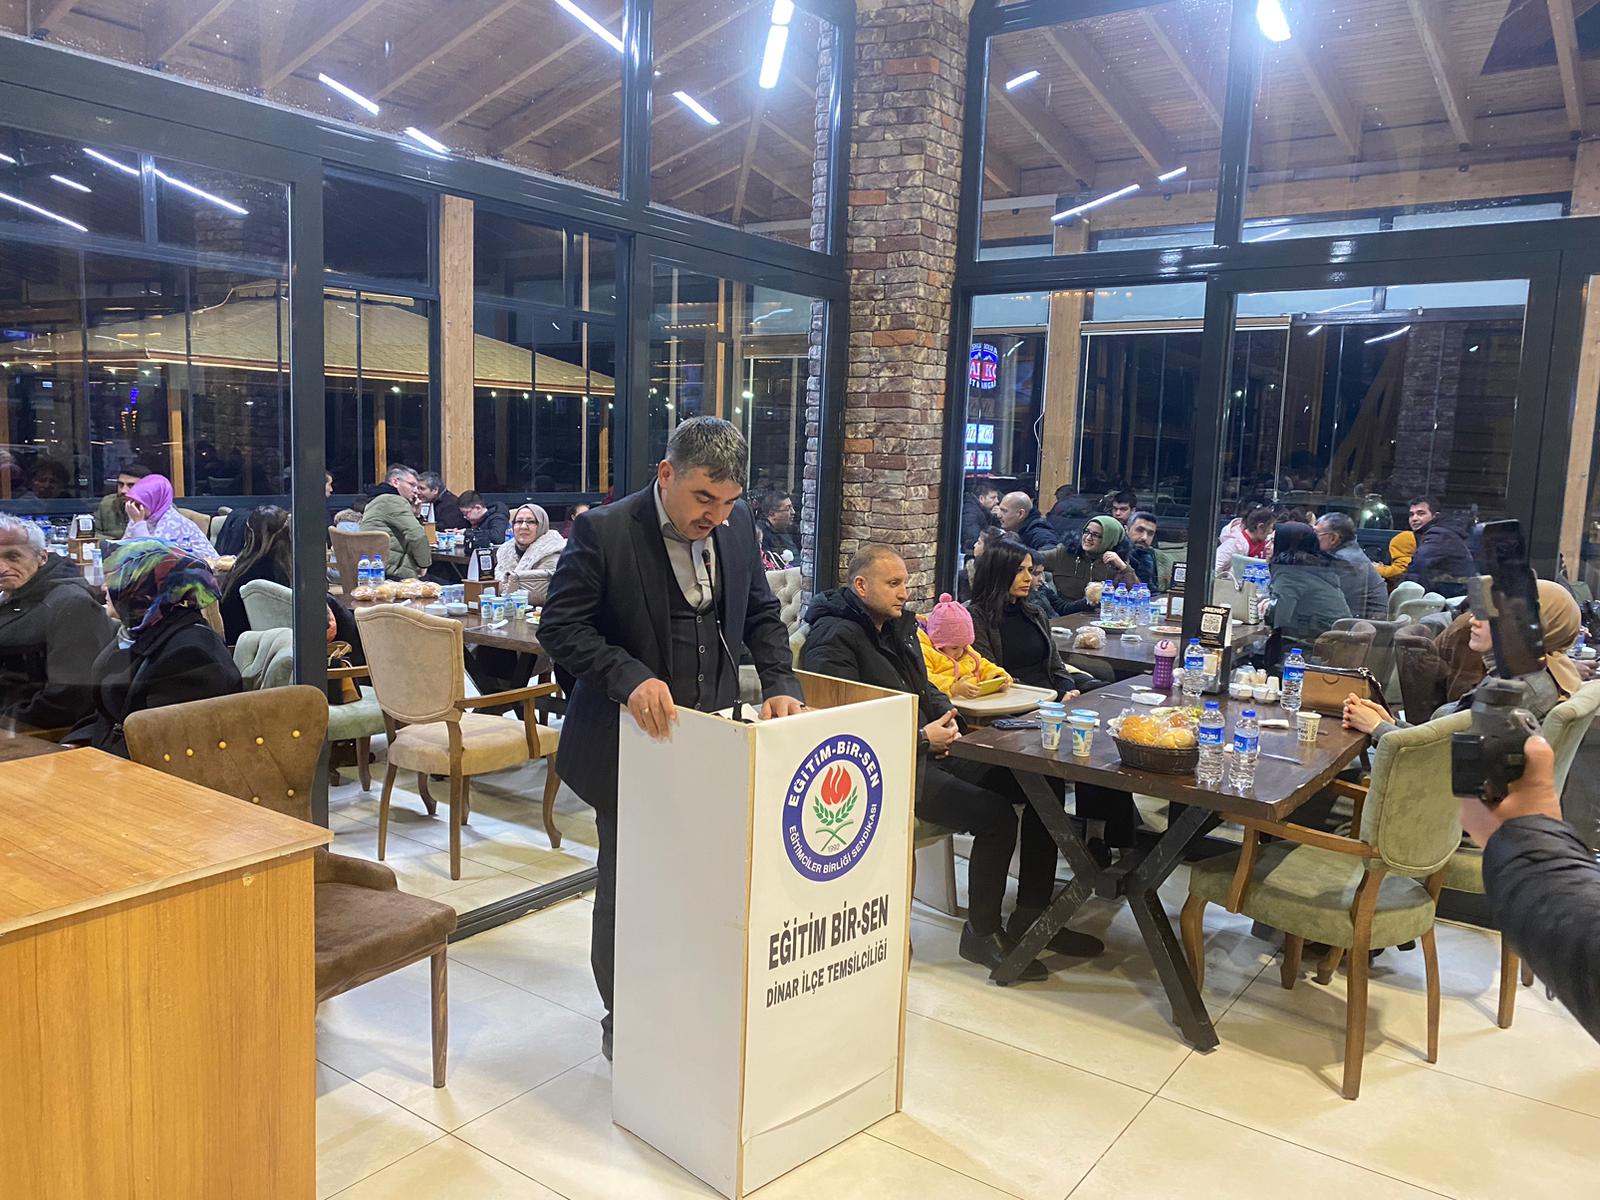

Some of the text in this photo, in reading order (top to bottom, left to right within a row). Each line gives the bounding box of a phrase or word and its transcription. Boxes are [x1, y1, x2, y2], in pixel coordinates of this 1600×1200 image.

[789, 803, 878, 874] EĞİTİMCİLER BİRLİĞİ SENDİKASI
[768, 894, 889, 971] EĞİTİM BİR-SEN
[766, 938, 888, 1008] DİNAR İLÇE TEMSİLCİLİĞİ
